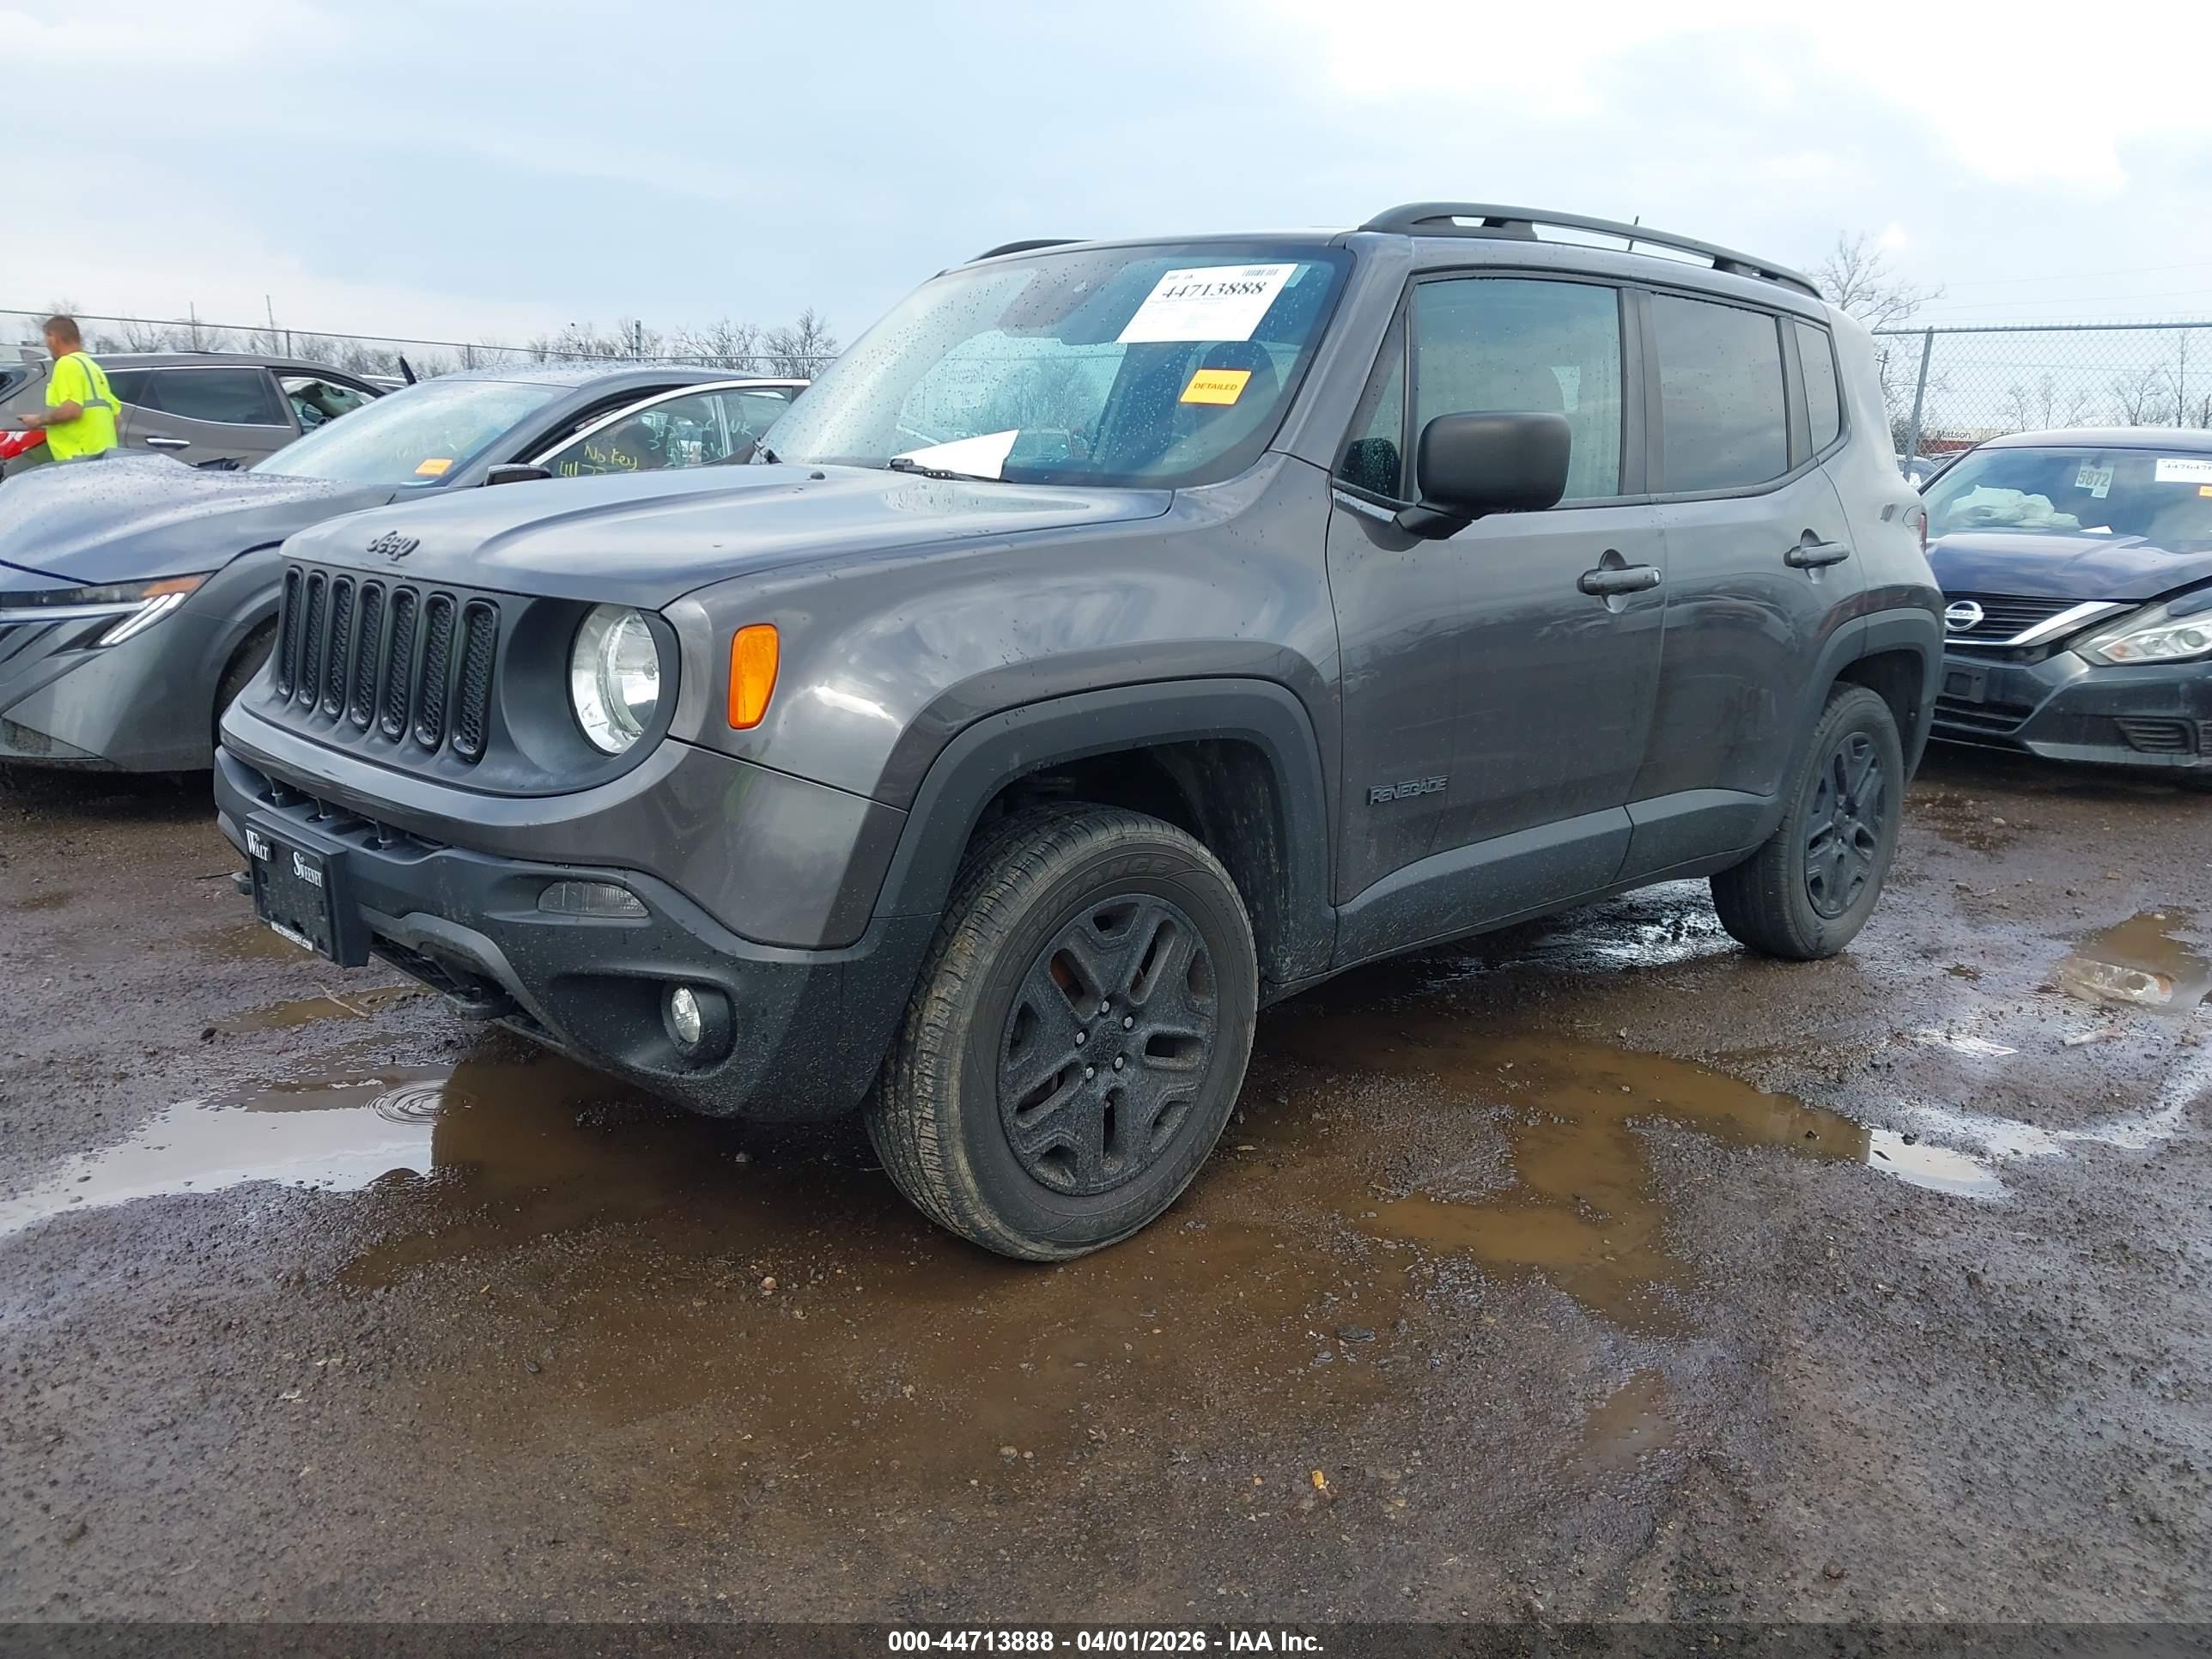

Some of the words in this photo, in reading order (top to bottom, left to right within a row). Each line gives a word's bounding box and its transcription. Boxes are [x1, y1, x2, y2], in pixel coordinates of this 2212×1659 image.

[1162, 282, 1267, 298] 44713888
[1194, 382, 1237, 391] DETAILED
[585, 445, 605, 462] No
[2078, 470, 2110, 487] 5872
[1366, 775, 1449, 805] RENEGADE
